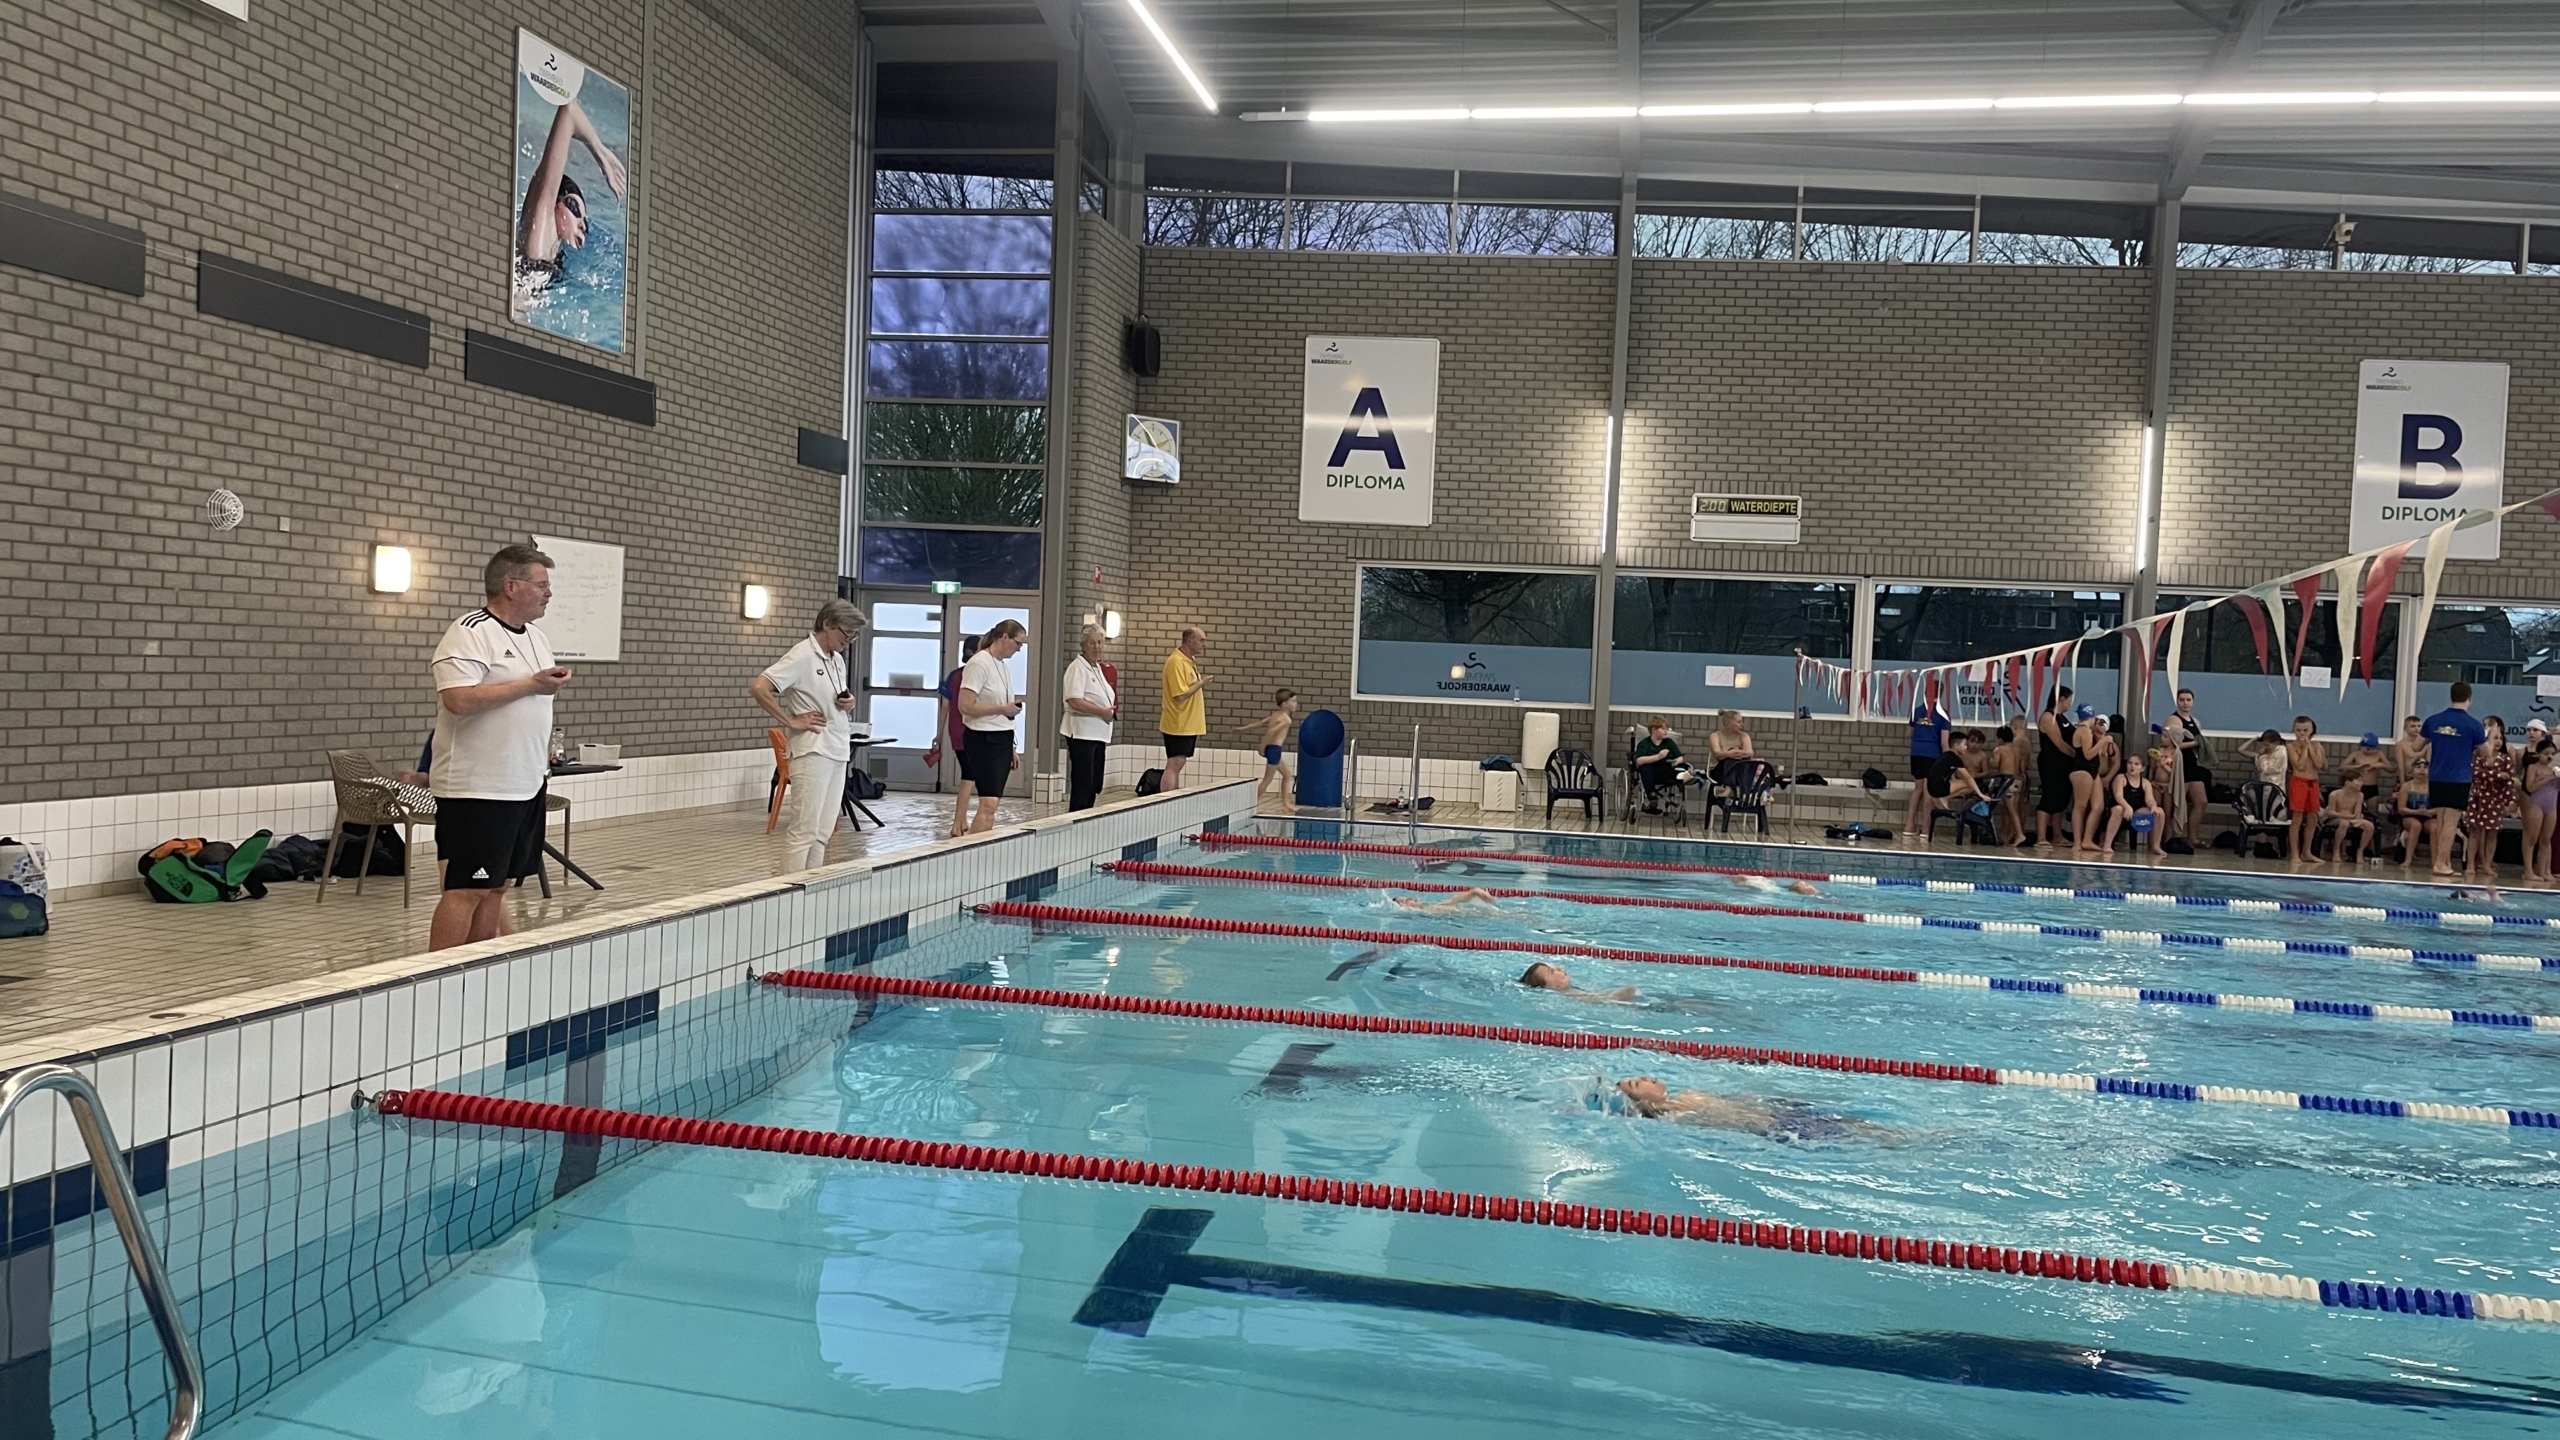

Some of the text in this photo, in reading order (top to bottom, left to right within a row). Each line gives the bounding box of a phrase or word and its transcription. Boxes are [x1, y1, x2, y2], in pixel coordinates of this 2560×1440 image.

[1327, 387, 1406, 470] A
[2398, 413, 2463, 500] B
[1326, 474, 1405, 490] DIPLOMA
[1731, 501, 1797, 513] WATERDIEPTE
